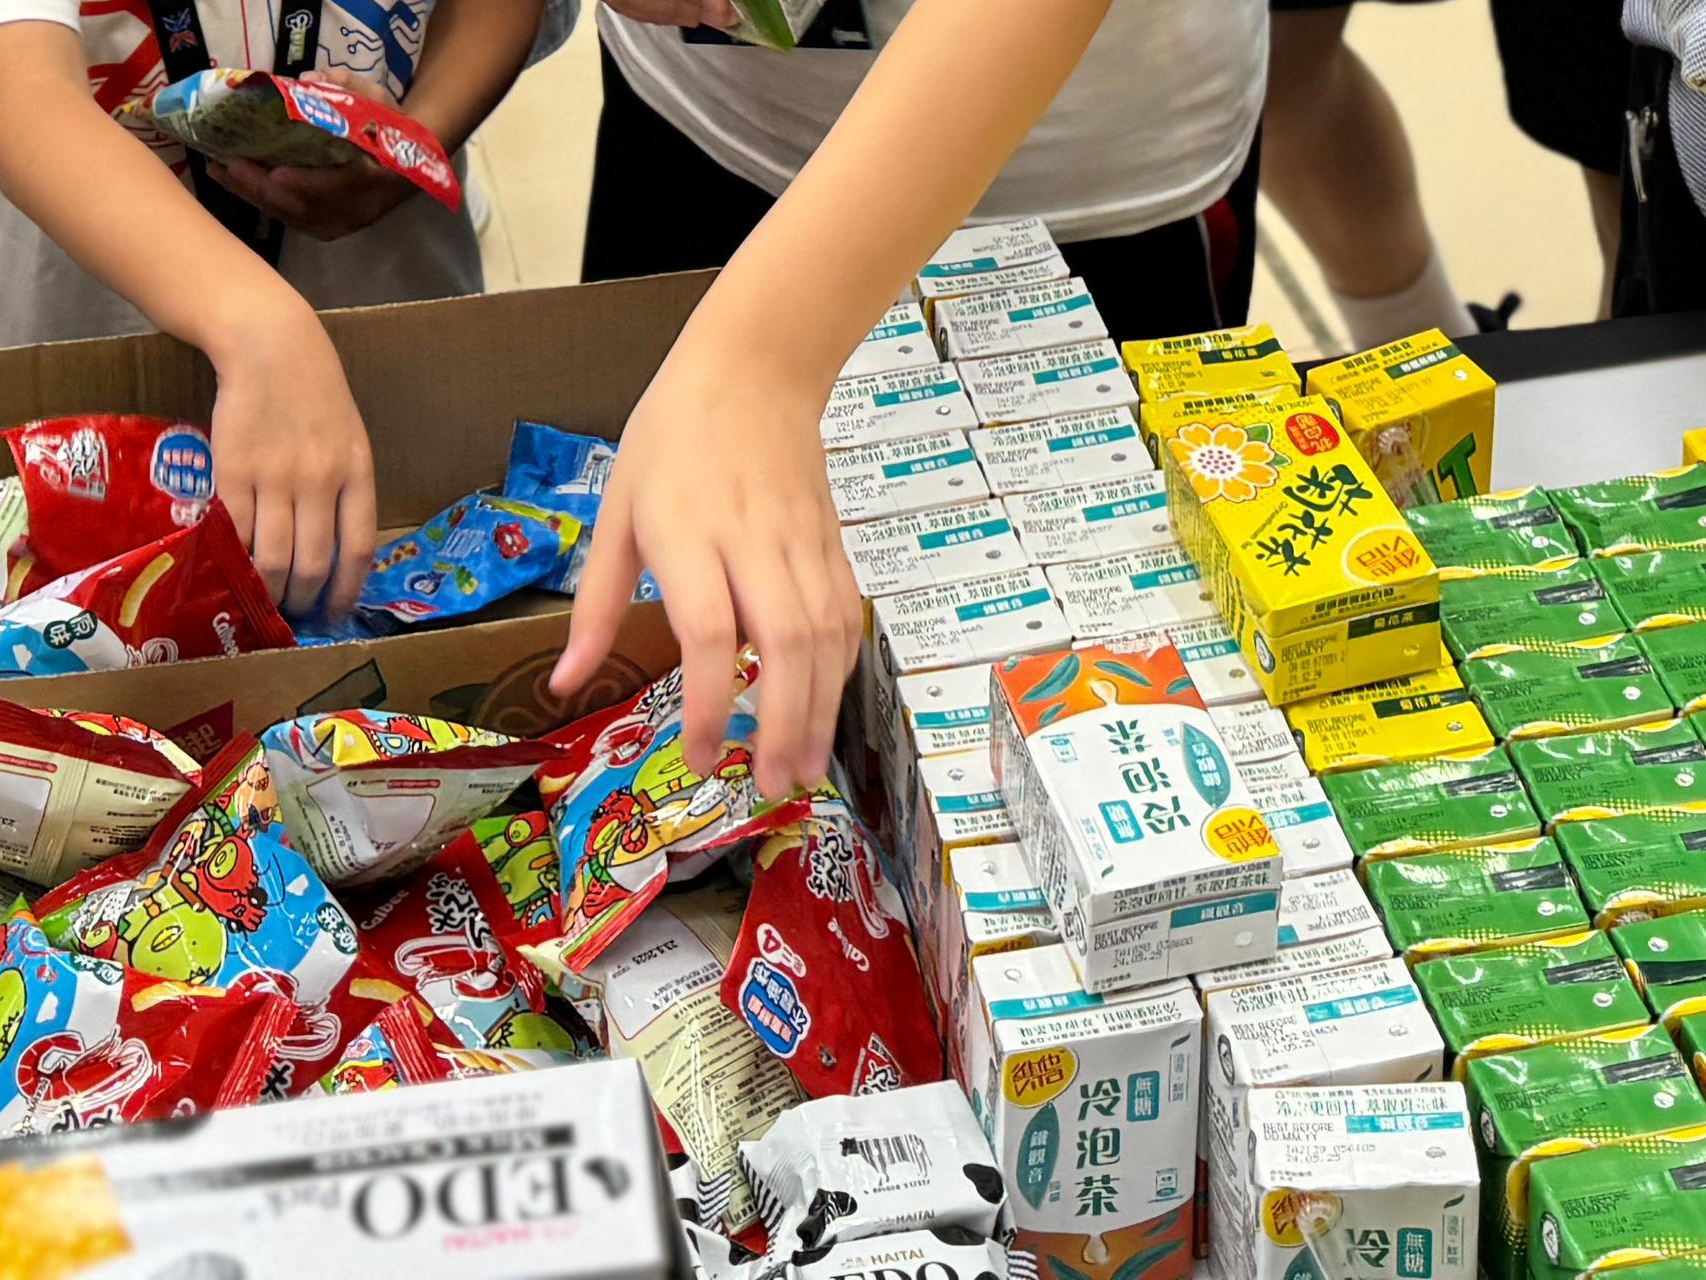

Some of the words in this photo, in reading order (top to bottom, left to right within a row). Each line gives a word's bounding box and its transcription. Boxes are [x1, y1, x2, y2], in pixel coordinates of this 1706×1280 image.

[1253, 463, 1374, 577] 菊花茶
[1100, 719, 1190, 835] 冷泡茶
[359, 887, 410, 932] Calbee
[1012, 1054, 1061, 1082] 維他
[1134, 1077, 1152, 1116] 無糖
[1028, 1130, 1048, 1184] 鐵觀音
[1075, 1078, 1121, 1217] 冷泡茶
[353, 1155, 580, 1238] EDO
[870, 1249, 925, 1265] HAITAI
[1405, 1232, 1425, 1273] 無糖
